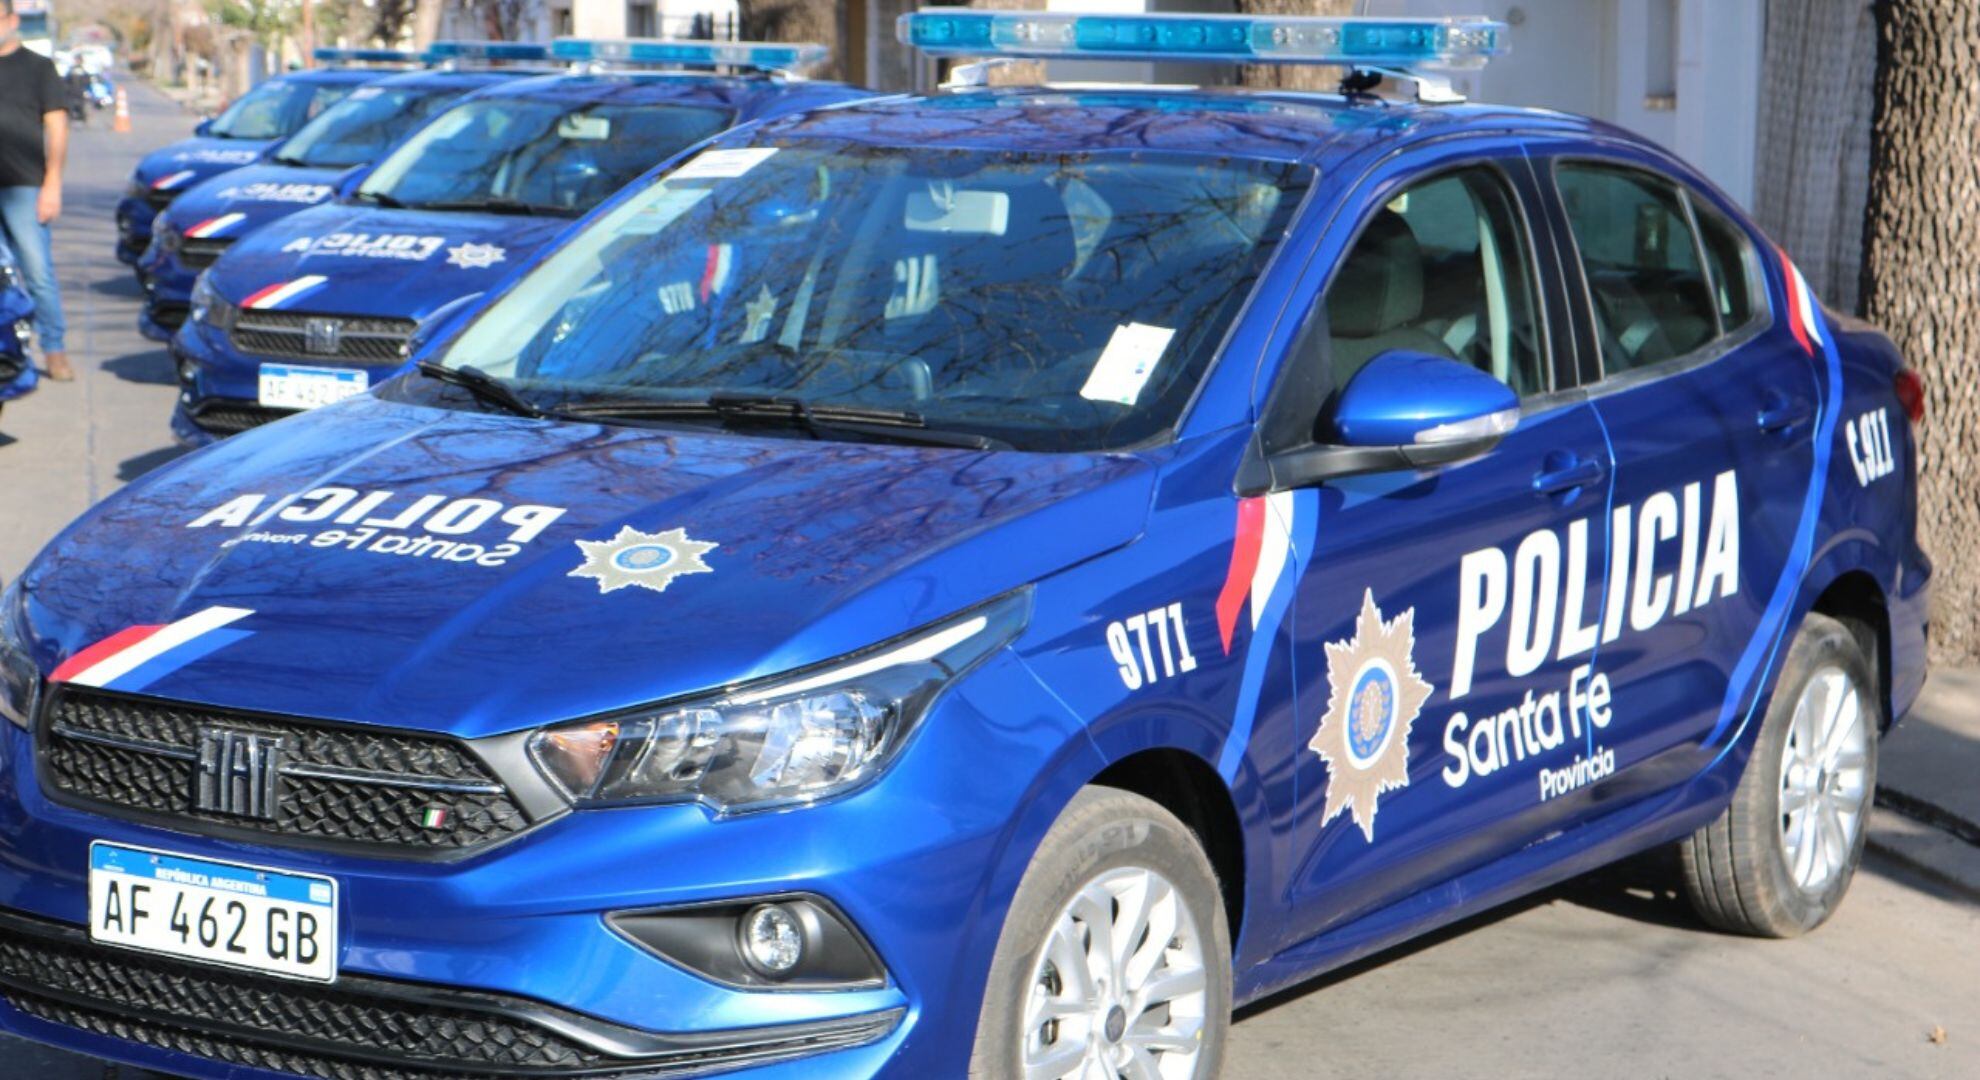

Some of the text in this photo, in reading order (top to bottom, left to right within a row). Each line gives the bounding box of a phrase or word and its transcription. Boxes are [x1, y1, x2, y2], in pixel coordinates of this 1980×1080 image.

[1450, 469, 1739, 700] POLICIA
[1106, 602, 1197, 690] 9771
[1442, 664, 1613, 788] Santa Fe
[1539, 745, 1615, 802] Provincia
[104, 880, 318, 964] AF 462 GB
